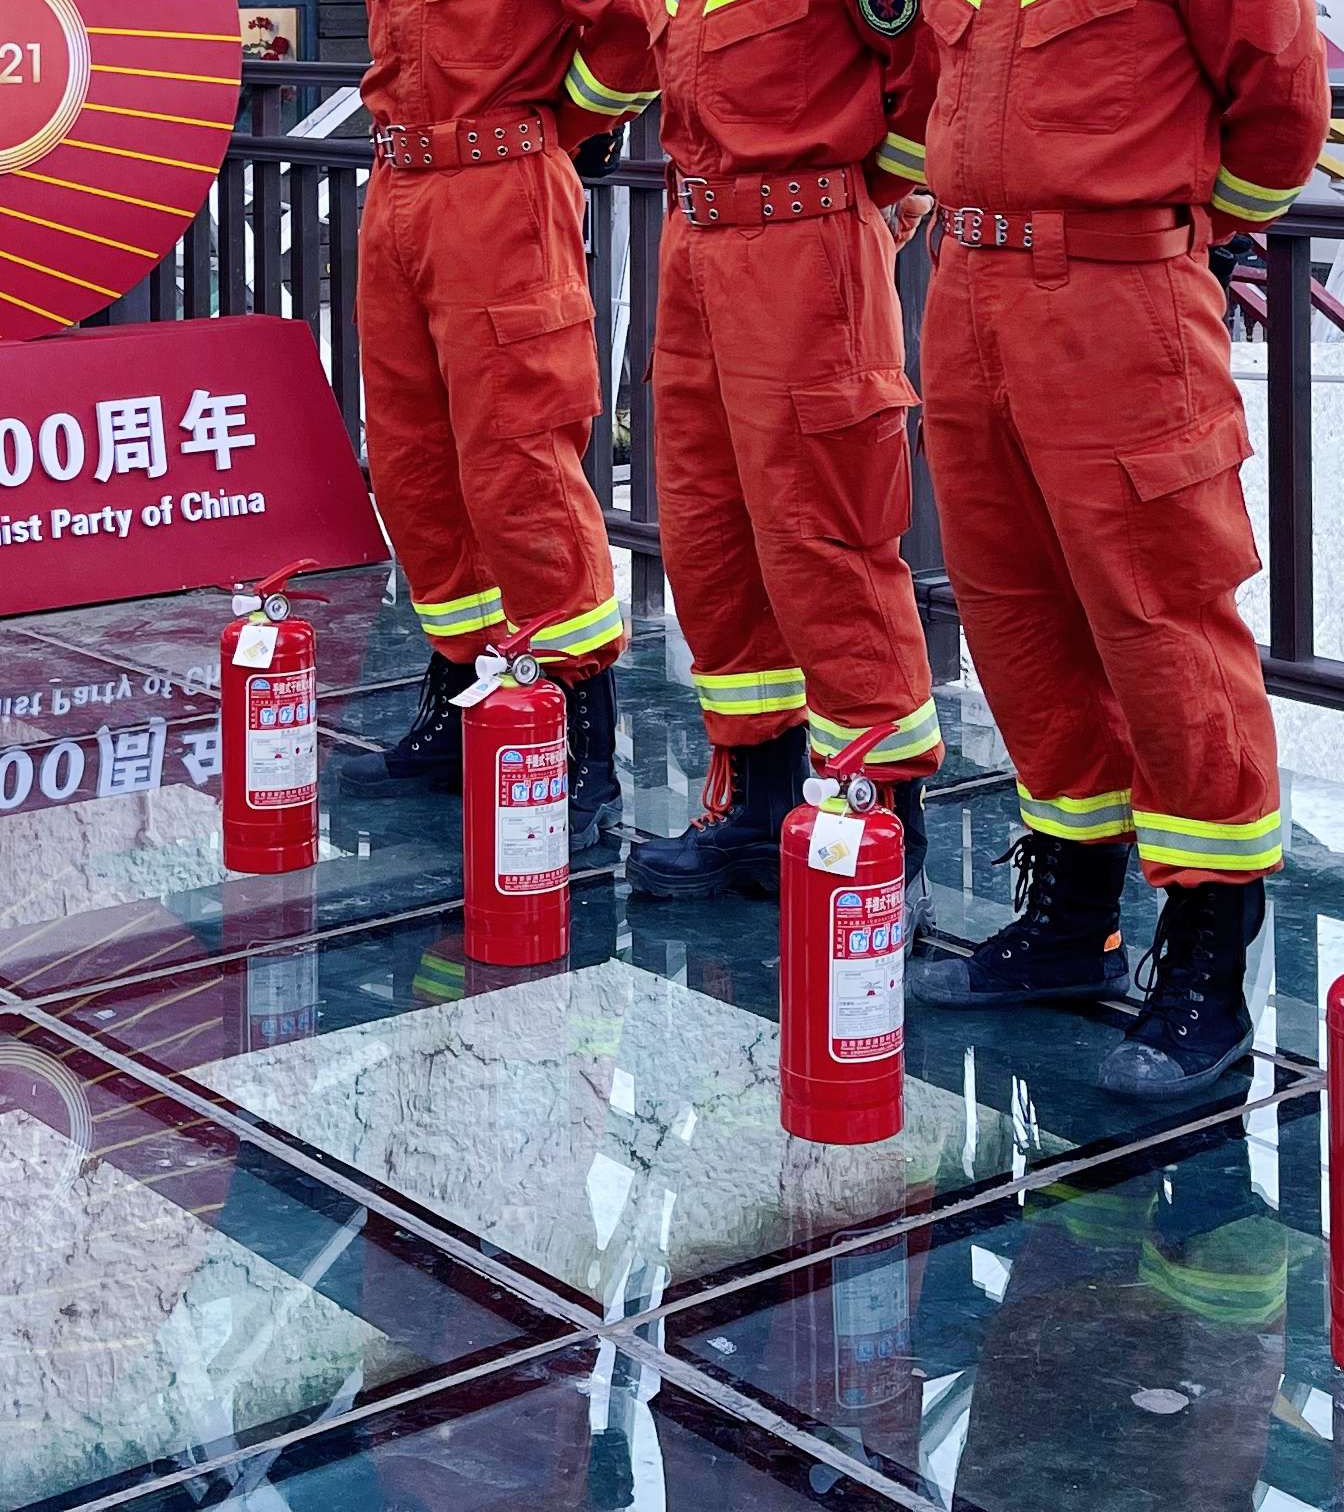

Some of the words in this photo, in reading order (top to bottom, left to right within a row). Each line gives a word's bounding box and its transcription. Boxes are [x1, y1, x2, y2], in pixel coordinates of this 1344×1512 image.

[51, 504, 133, 539] Party
[142, 495, 174, 527] of
[180, 490, 267, 521] China
